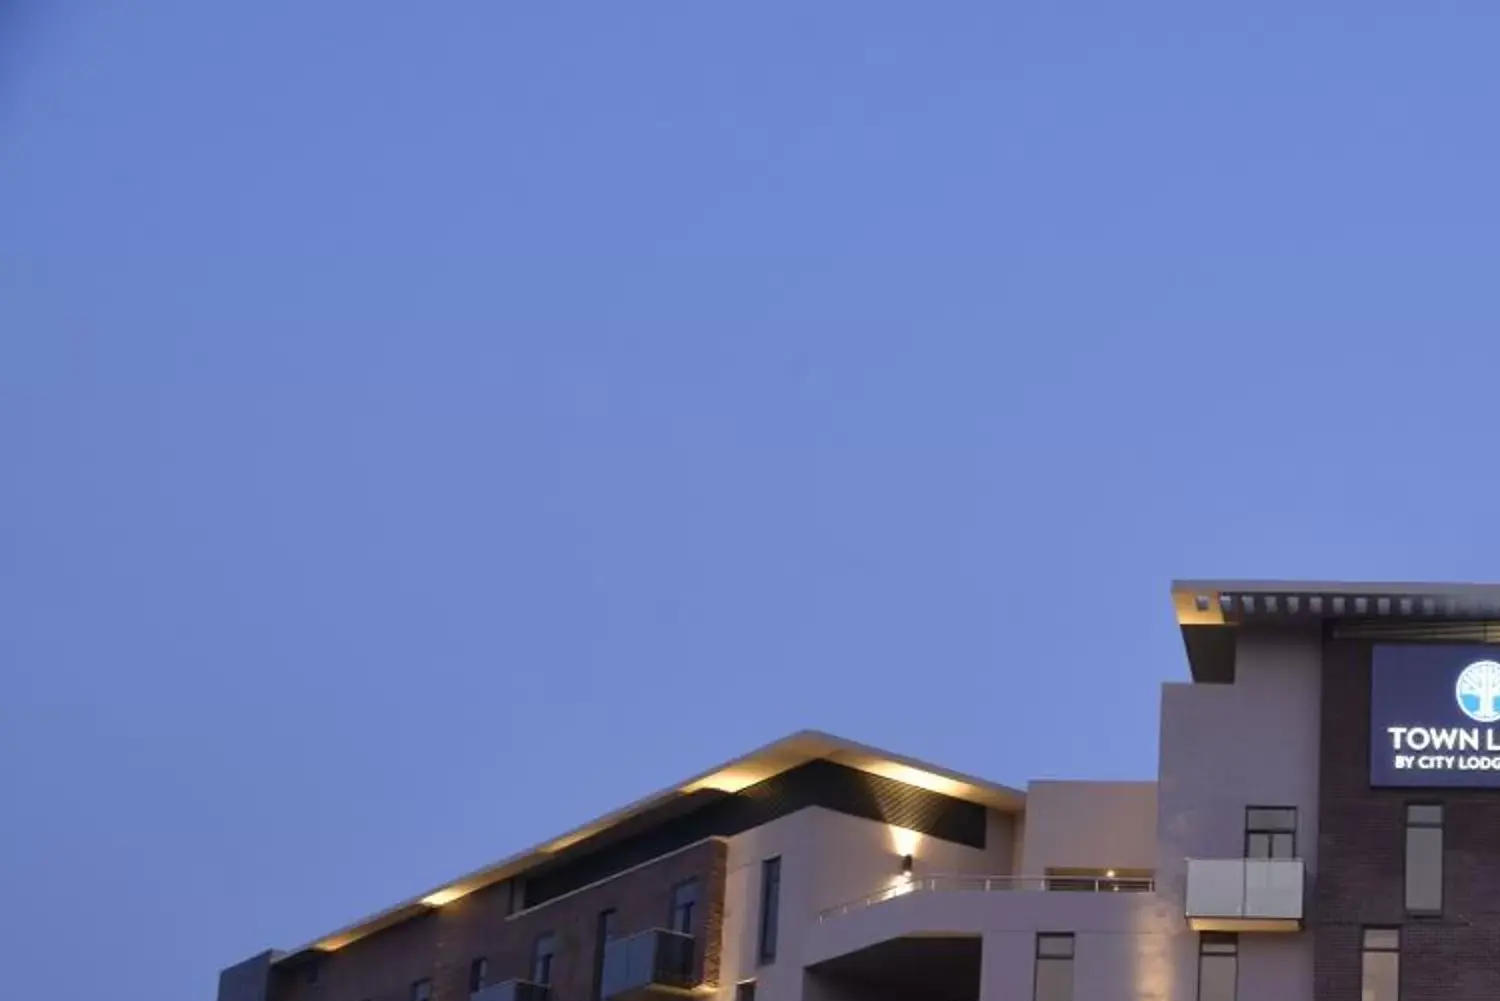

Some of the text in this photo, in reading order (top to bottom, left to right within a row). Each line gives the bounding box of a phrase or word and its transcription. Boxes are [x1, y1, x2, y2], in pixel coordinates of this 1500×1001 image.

[1387, 726, 1479, 751] TOWN
[1395, 755, 1416, 769] BY
[1418, 755, 1455, 770] CITY
